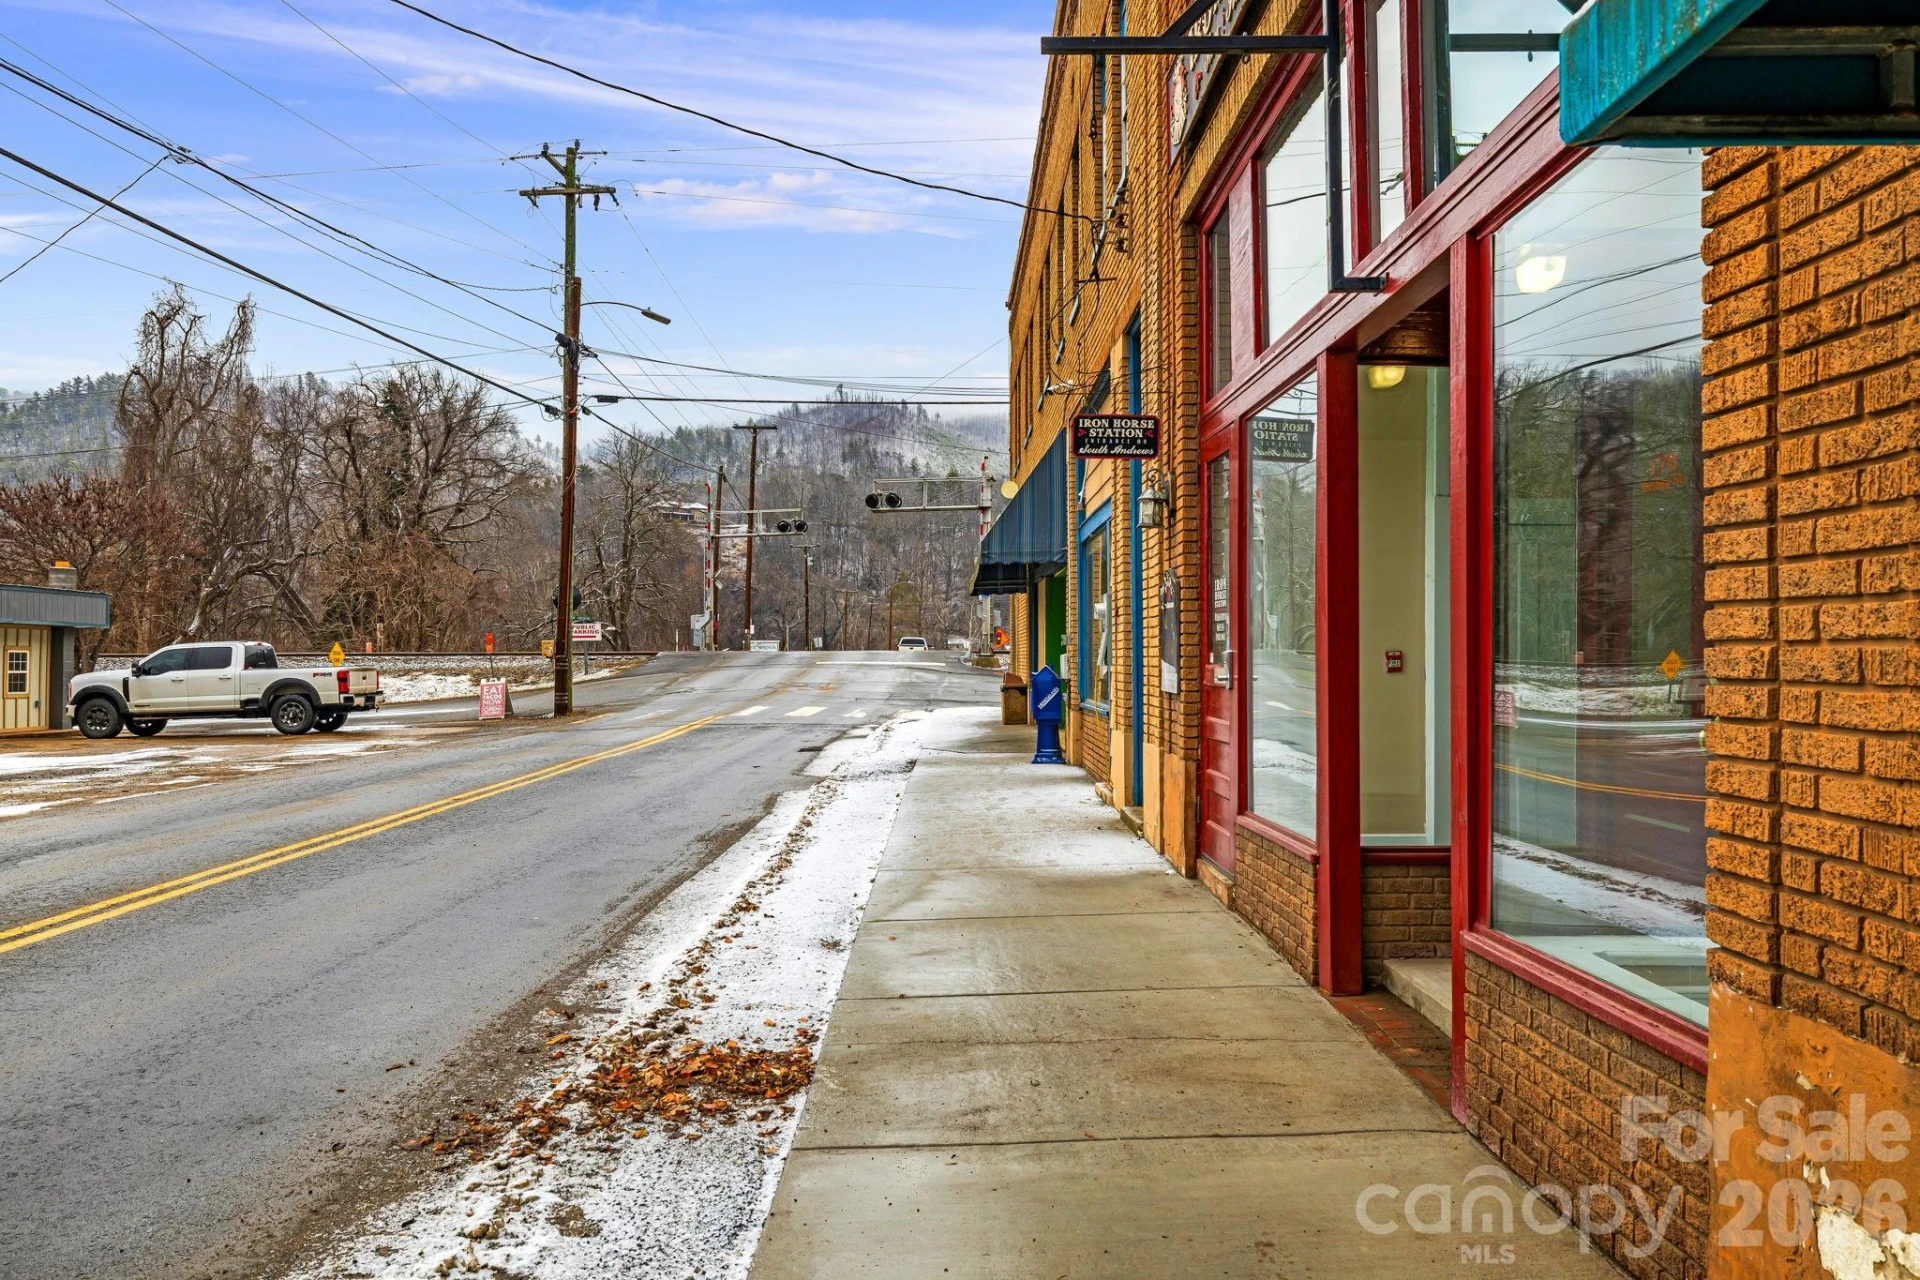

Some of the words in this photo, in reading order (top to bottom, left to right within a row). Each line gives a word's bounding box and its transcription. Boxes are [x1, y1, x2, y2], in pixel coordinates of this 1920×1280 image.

[1078, 418, 1110, 428] IRON
[1113, 419, 1155, 429] HORSE
[1089, 428, 1144, 438] STATION
[1078, 444, 1109, 454] South
[1110, 444, 1154, 455] Andrews
[483, 685, 503, 695] EAT
